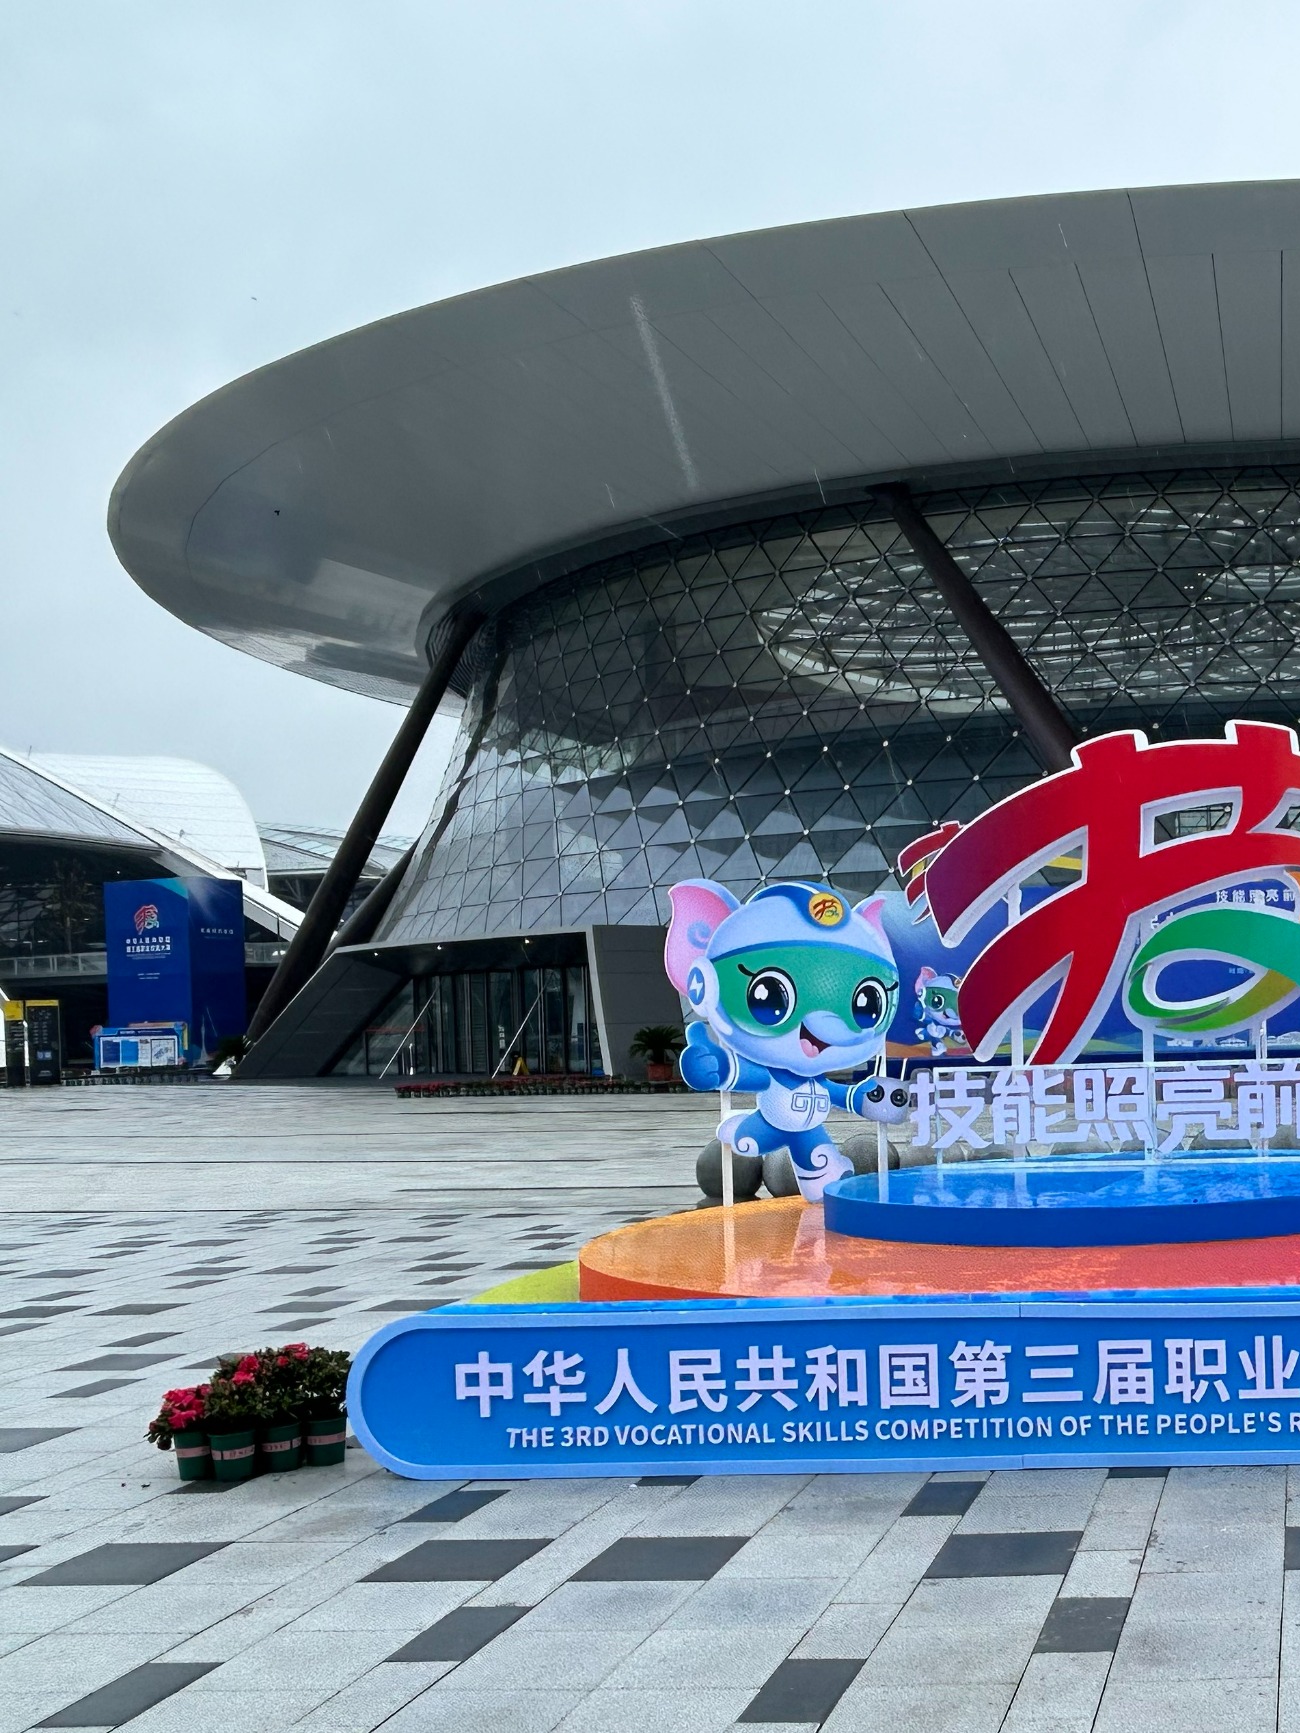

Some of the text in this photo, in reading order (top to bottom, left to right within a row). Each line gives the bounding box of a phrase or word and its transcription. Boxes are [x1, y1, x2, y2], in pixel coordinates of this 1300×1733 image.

[506, 1427, 554, 1448] THE
[561, 1426, 609, 1447] 3RD
[614, 1423, 776, 1446] VOCATIONAL
[782, 1420, 869, 1443] SKILLS
[875, 1416, 1052, 1440] COMPETITION
[1060, 1415, 1091, 1436] OF
[1099, 1414, 1149, 1435] THE
[1156, 1412, 1282, 1435] PEOPLE'S
